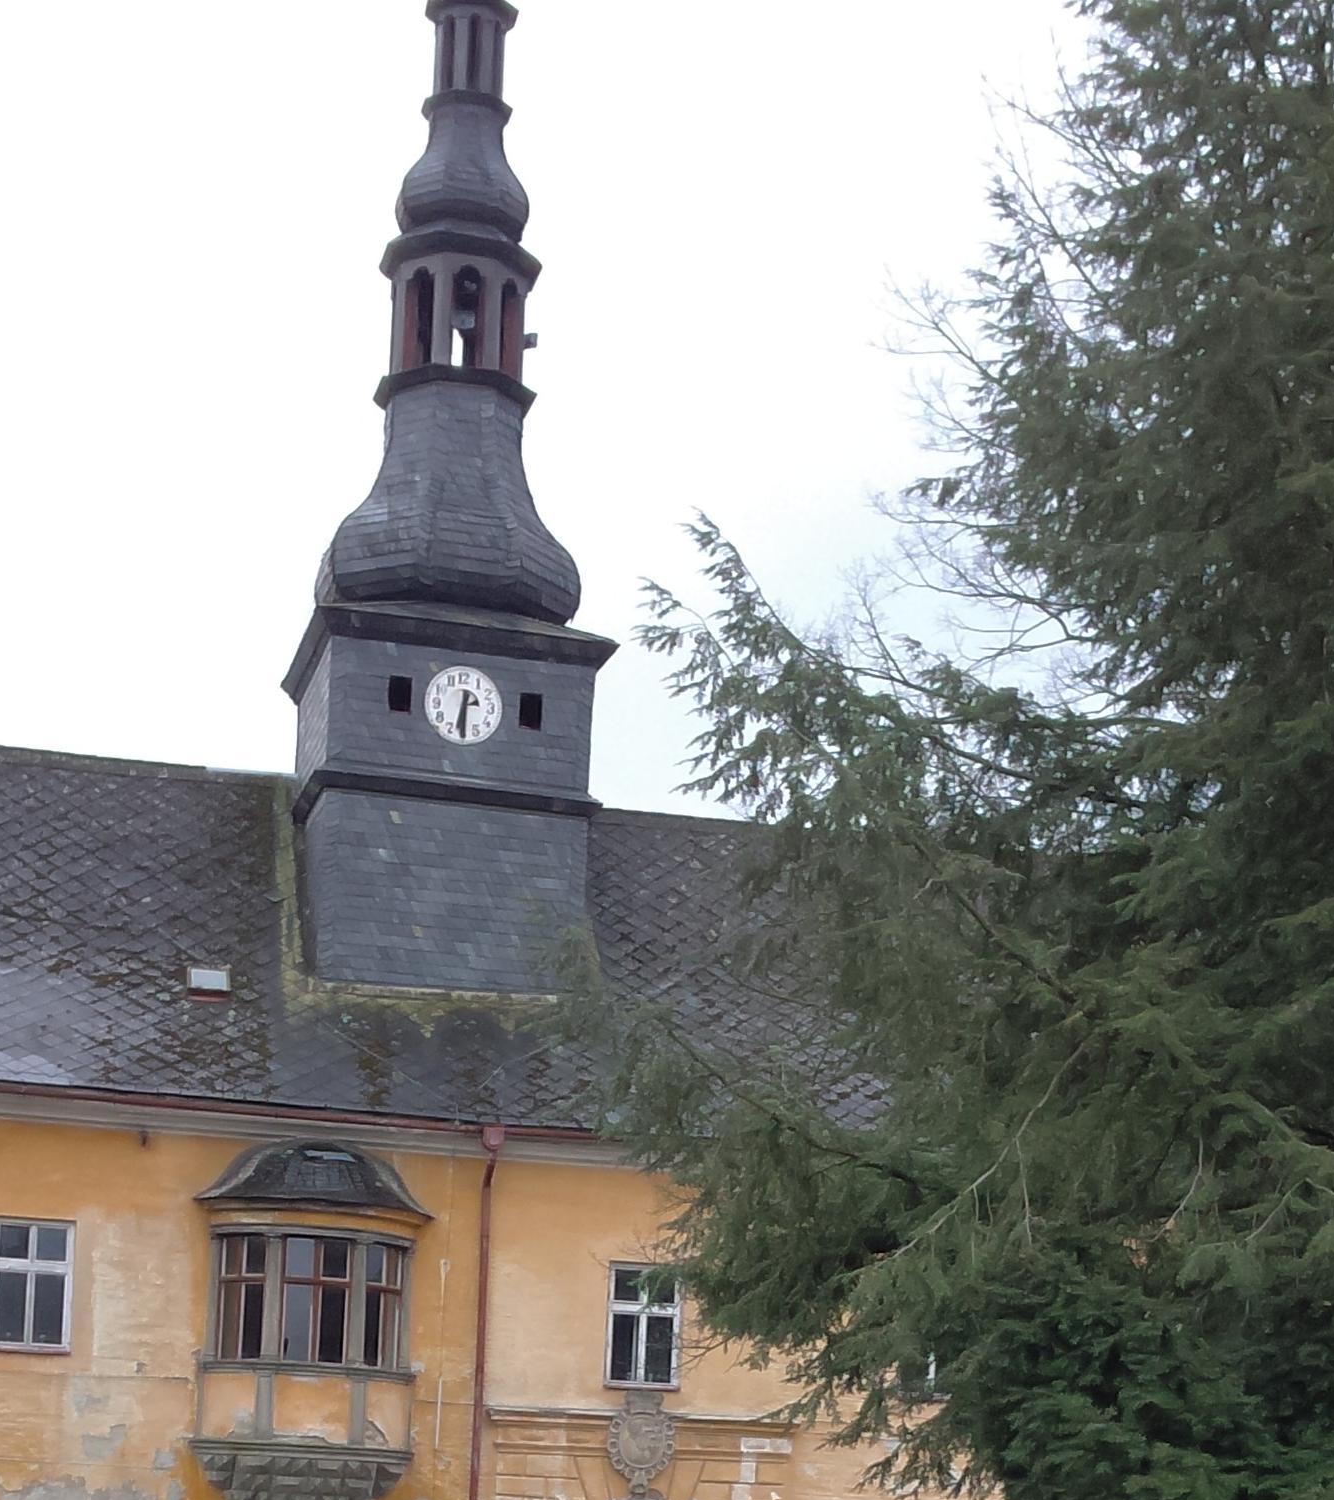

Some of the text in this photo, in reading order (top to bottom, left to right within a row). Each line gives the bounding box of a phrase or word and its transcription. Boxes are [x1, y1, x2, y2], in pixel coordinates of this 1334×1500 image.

[447, 674, 455, 687] 11
[458, 672, 470, 684] 12
[476, 678, 480, 689] 1
[484, 688, 492, 701] 2
[432, 697, 441, 709] 9
[486, 702, 495, 715] 3
[436, 711, 444, 723] 8
[482, 716, 491, 728] 4
[445, 722, 453, 734] 7
[472, 724, 480, 737] 5
